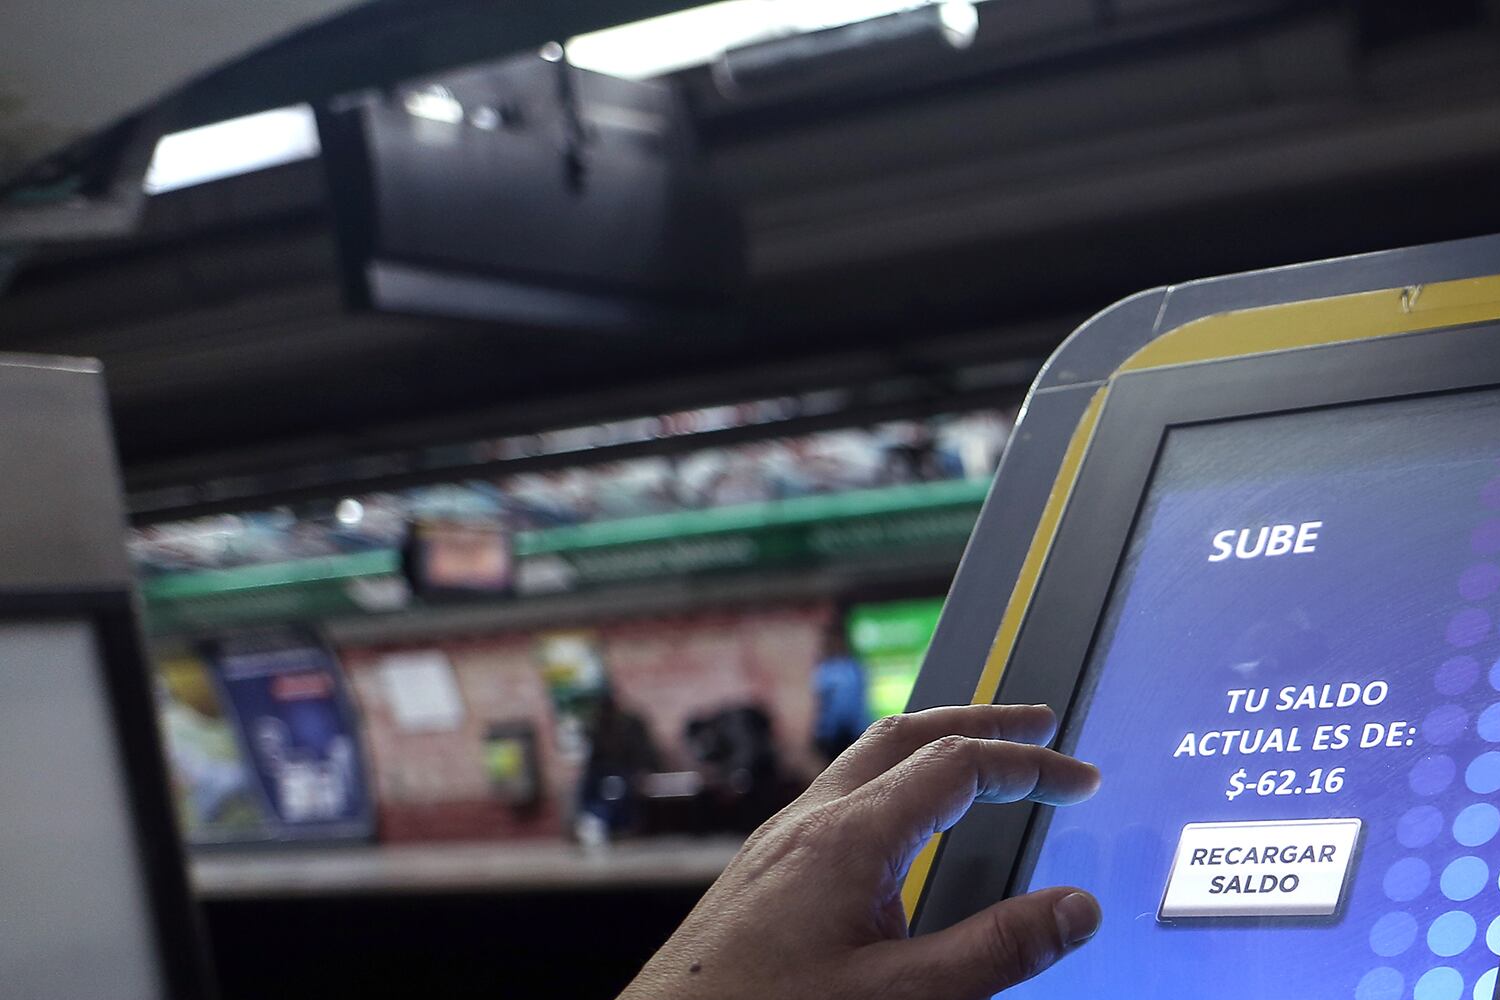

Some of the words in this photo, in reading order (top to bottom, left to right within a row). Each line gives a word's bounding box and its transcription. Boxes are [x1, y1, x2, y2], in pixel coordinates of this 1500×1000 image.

[1207, 520, 1323, 563] SUBE
[1226, 688, 1270, 714] TU
[1275, 680, 1389, 711] SALDO
[1173, 727, 1302, 758] ACTUAL
[1312, 725, 1352, 751] ES
[1359, 721, 1417, 749] DE:
[1225, 767, 1347, 801] $-62.16
[1189, 845, 1337, 866] RECARGAR
[1208, 874, 1301, 895] SALDO
